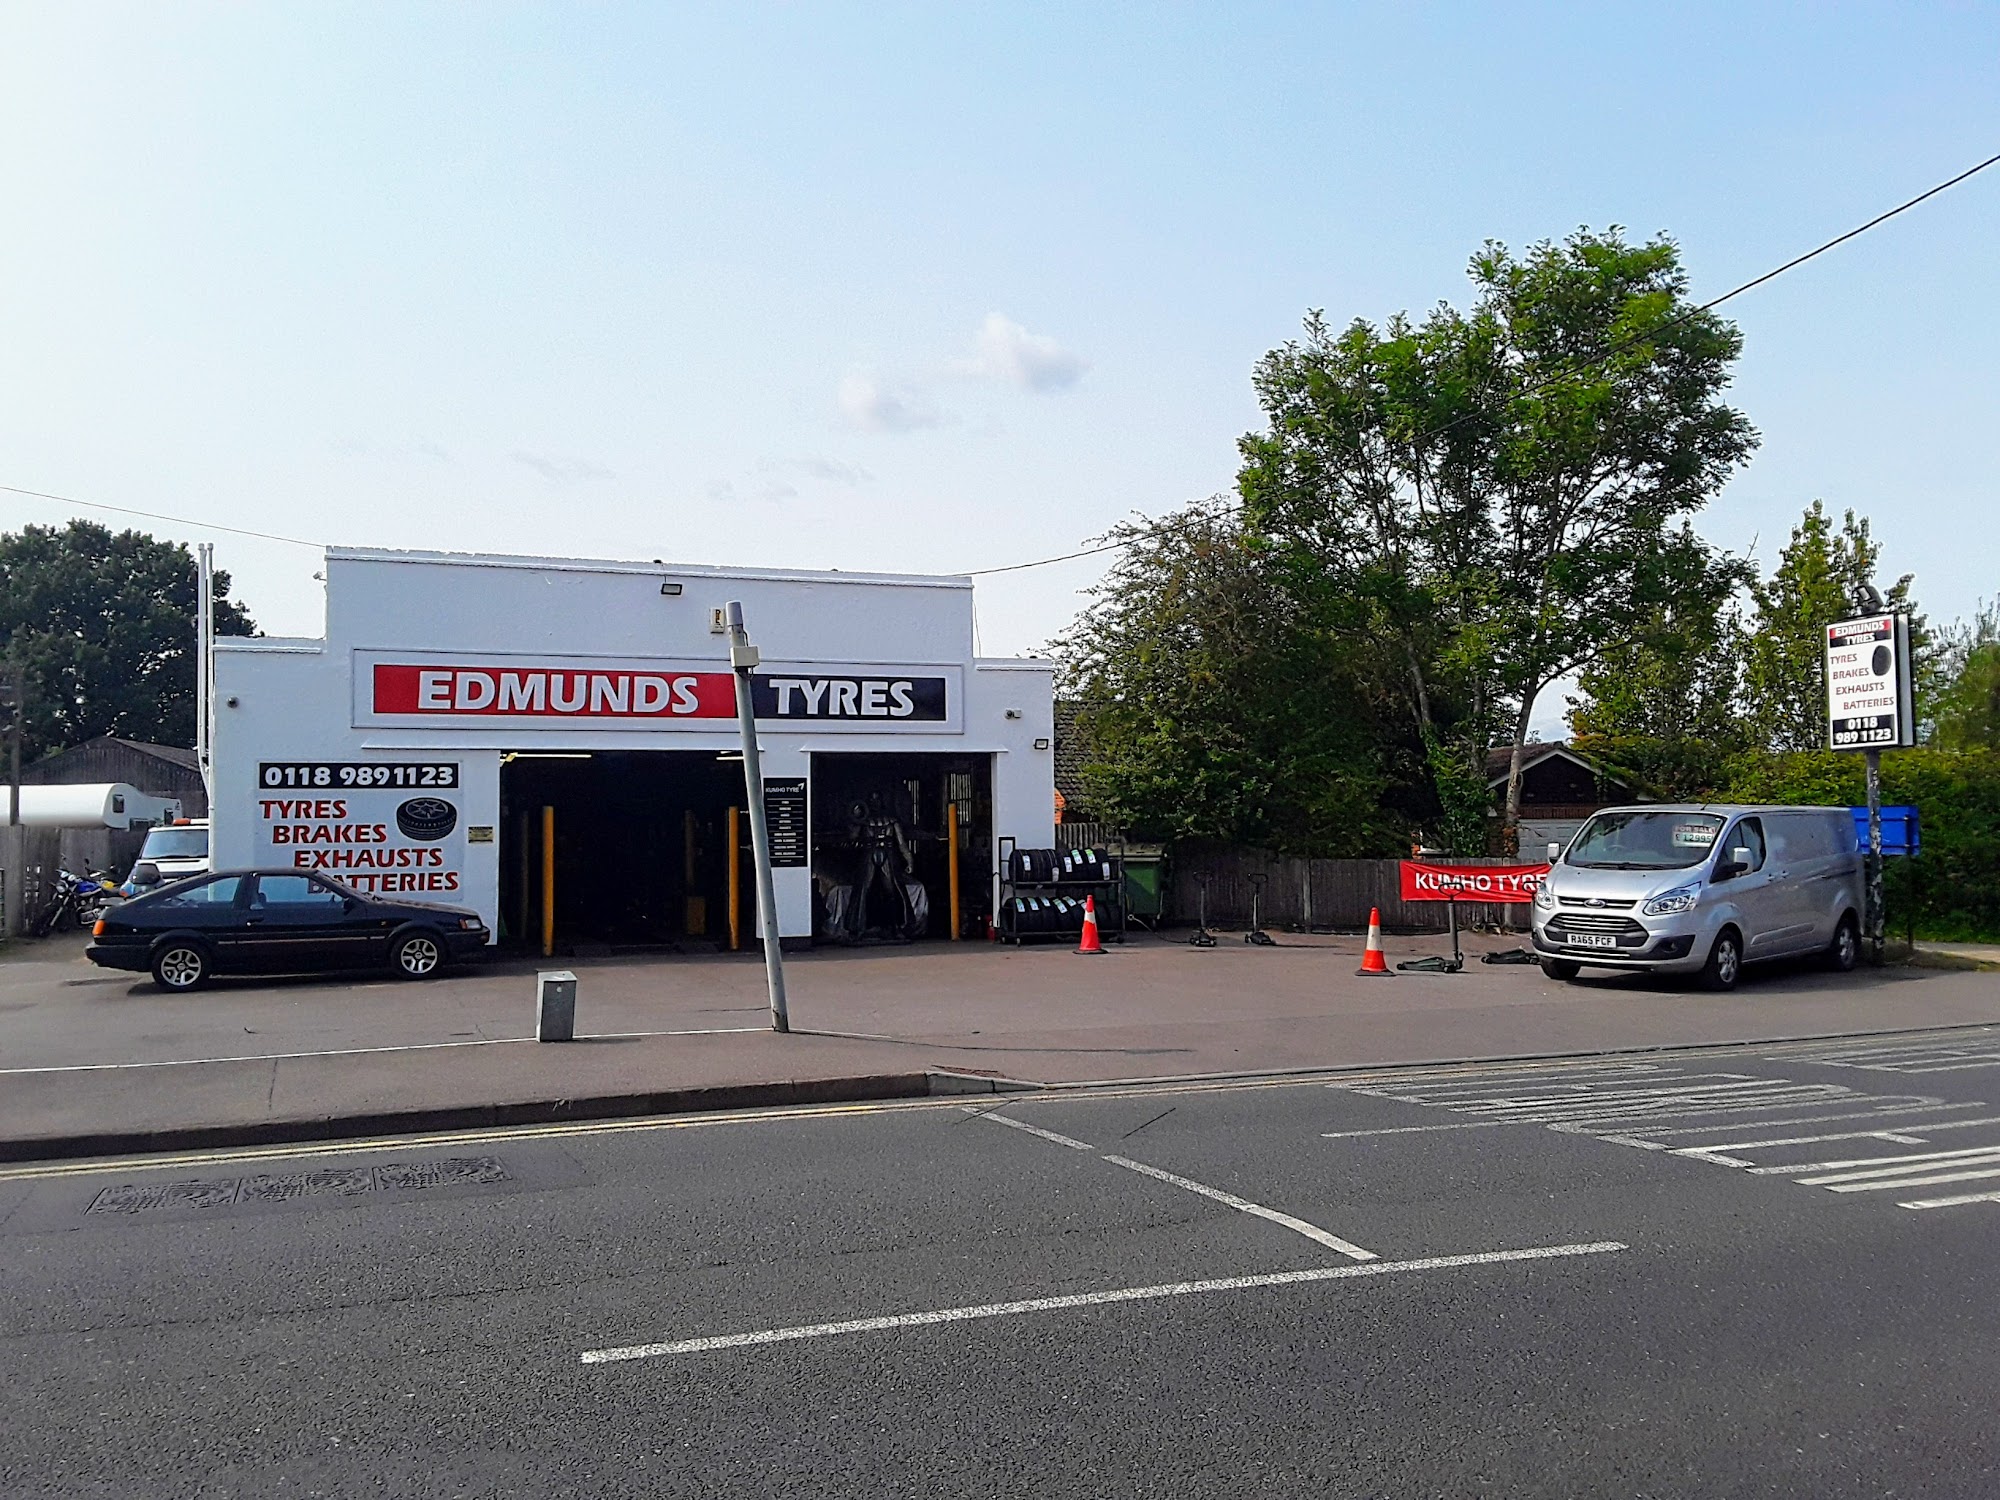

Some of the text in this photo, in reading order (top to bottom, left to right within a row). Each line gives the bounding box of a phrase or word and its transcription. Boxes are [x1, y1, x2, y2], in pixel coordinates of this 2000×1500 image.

[1835, 620, 1885, 637] EDMUNDS
[1845, 632, 1875, 645] TYRES
[1830, 653, 1858, 664] TYRES
[1833, 667, 1869, 679] BRAKES
[418, 671, 914, 717] EDMUNDS TYRES
[1836, 682, 1885, 695] EXHAUSTS
[1843, 697, 1894, 710] BATTERIES
[1847, 716, 1879, 730] 0118
[1835, 728, 1892, 744] 989 1123
[265, 766, 331, 786] 0118
[259, 800, 347, 819] TYRES
[272, 824, 387, 844] BRAKES
[294, 848, 443, 868] EXHAUSTS
[1415, 872, 1492, 892] KUMHO
[1571, 934, 1612, 946] RA65 FCF
